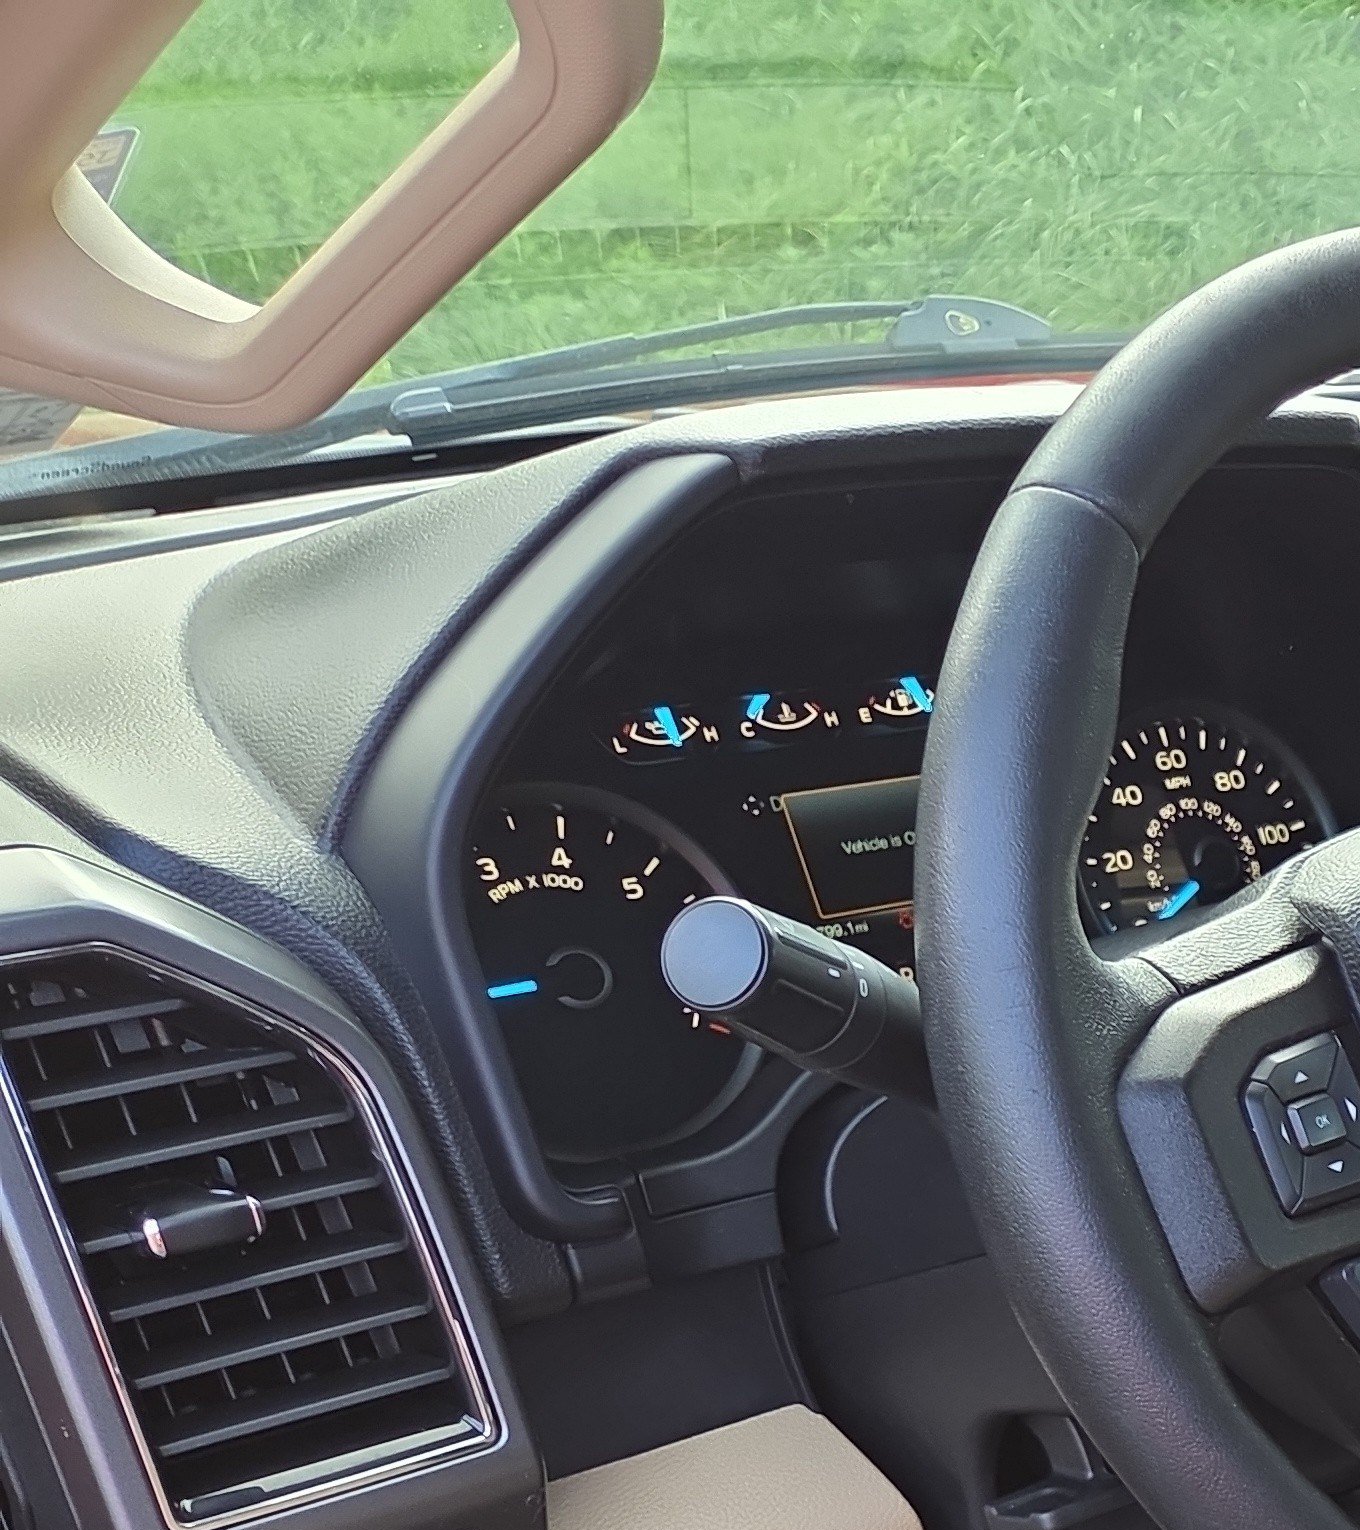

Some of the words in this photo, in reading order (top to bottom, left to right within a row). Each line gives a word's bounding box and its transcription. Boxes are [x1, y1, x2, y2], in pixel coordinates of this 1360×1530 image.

[825, 711, 840, 727] H
[858, 707, 873, 723] E
[703, 725, 720, 743] H
[740, 722, 756, 738] C
[612, 737, 628, 754] L
[1155, 748, 1187, 771] 60
[1163, 774, 1192, 790] MPH
[1214, 769, 1246, 792] 80
[1111, 785, 1143, 807] 40
[840, 836, 889, 855] Vehicle
[890, 833, 903, 848] is
[903, 831, 917, 846] O
[1256, 823, 1290, 846] 100
[475, 857, 500, 881] 3
[551, 847, 573, 869] 4
[1101, 849, 1134, 874] 20
[487, 877, 524, 904] RPM
[525, 874, 541, 890] X
[541, 873, 584, 891] 1000
[621, 876, 644, 900] 5
[1315, 1113, 1331, 1129] OK
